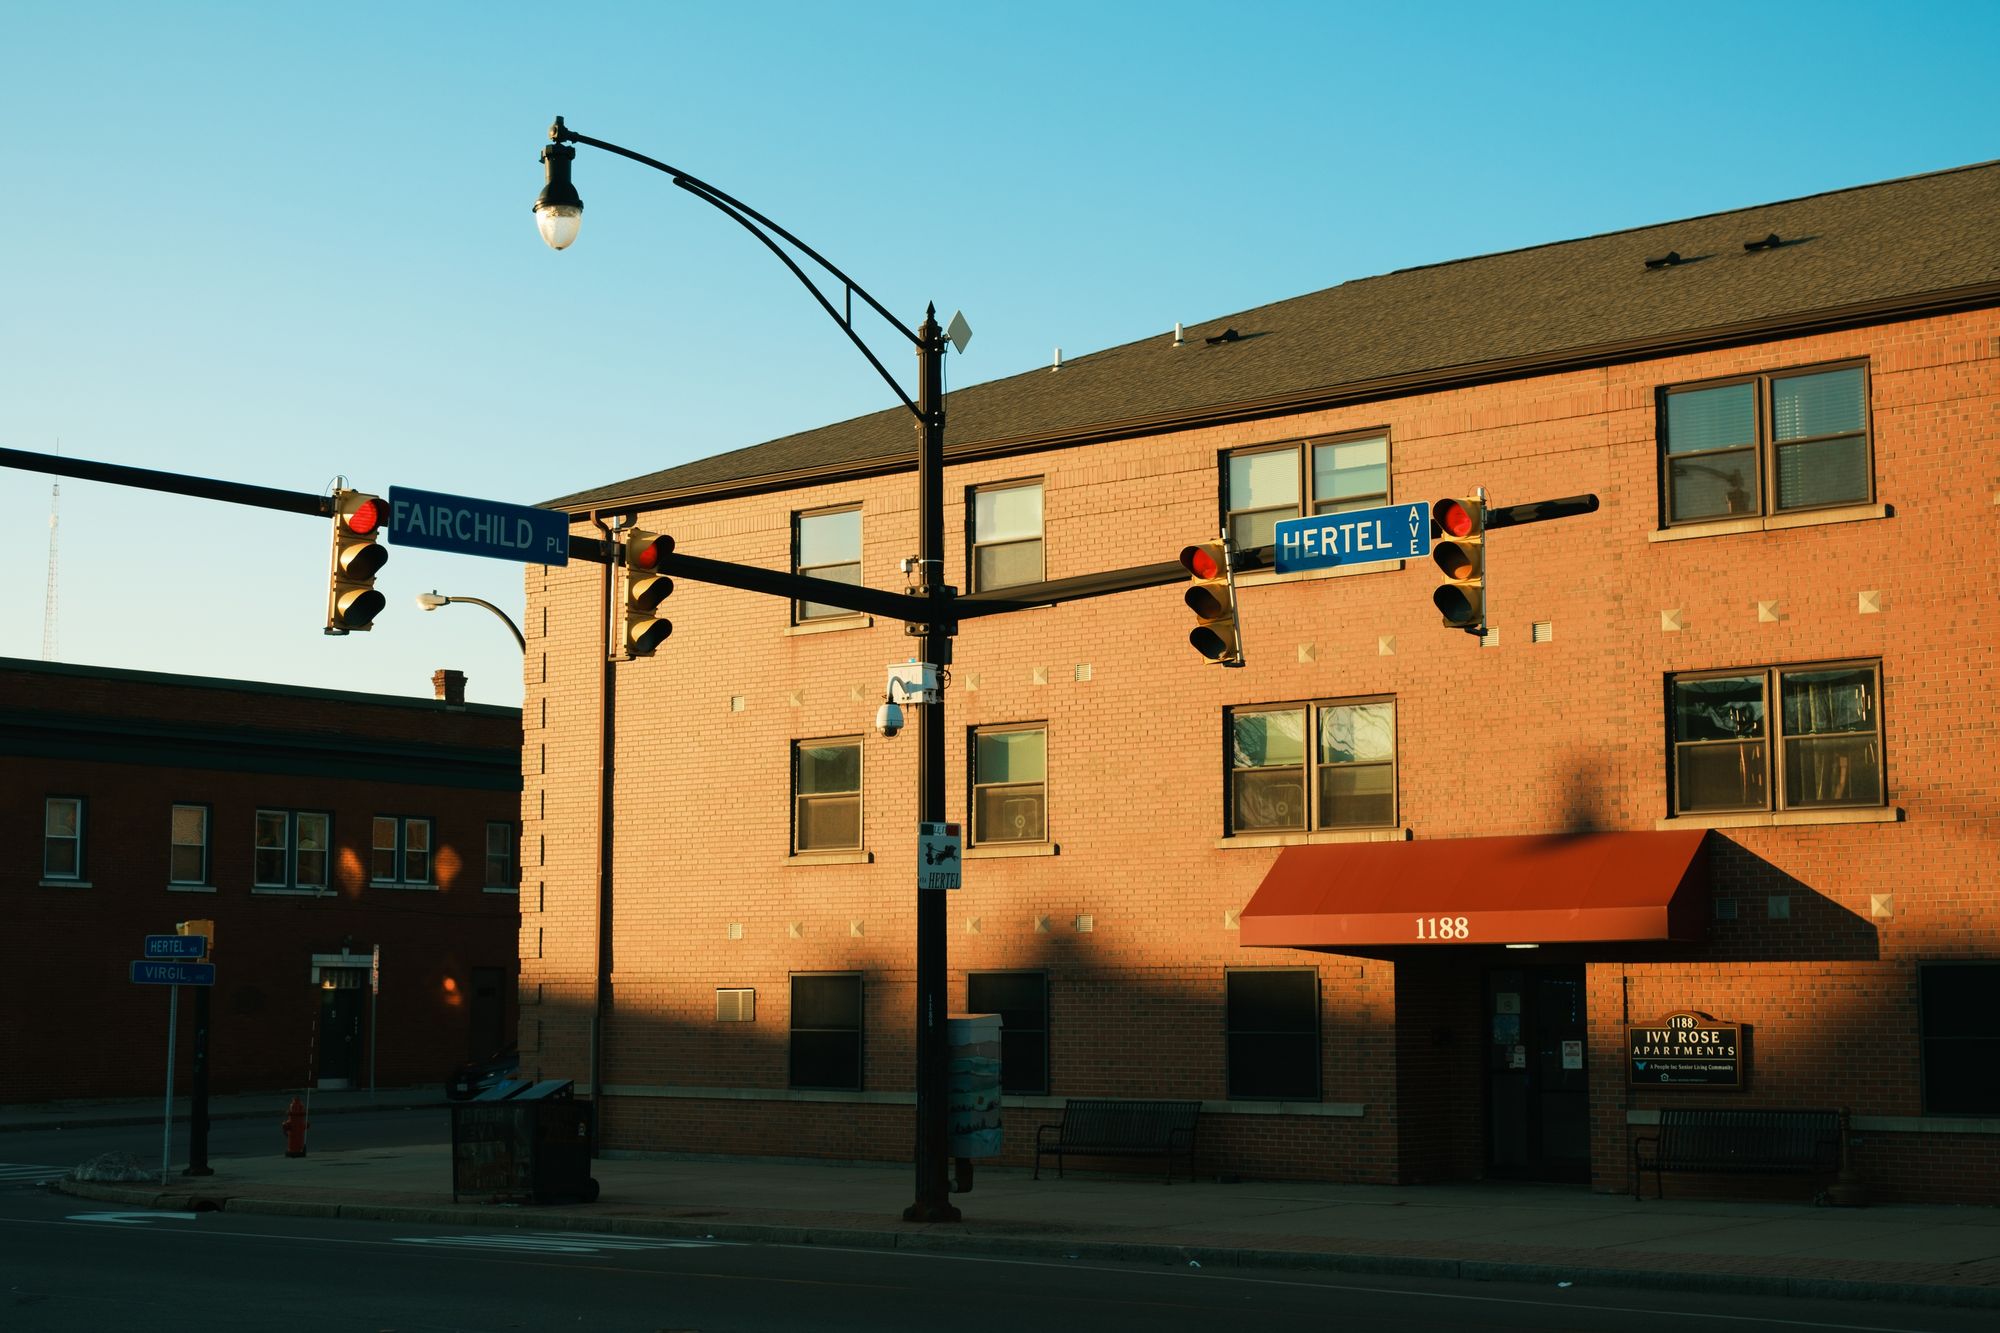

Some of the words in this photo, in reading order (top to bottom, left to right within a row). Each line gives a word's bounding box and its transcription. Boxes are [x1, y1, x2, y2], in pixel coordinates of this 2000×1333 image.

[393, 500, 533, 548] FAIRCHILD
[546, 536, 564, 554] PL
[1283, 519, 1393, 561] HERTEL
[1408, 506, 1420, 555] AVE
[928, 872, 960, 889] HERTEL
[1416, 917, 1469, 939] 1188
[150, 940, 185, 953] HERTEL
[145, 966, 187, 980] VIRGIL
[1671, 1017, 1694, 1029] 1188
[1646, 1031, 1671, 1043] IVY
[1678, 1031, 1720, 1043] ROSE
[1633, 1046, 1735, 1056] APARTMENTS
